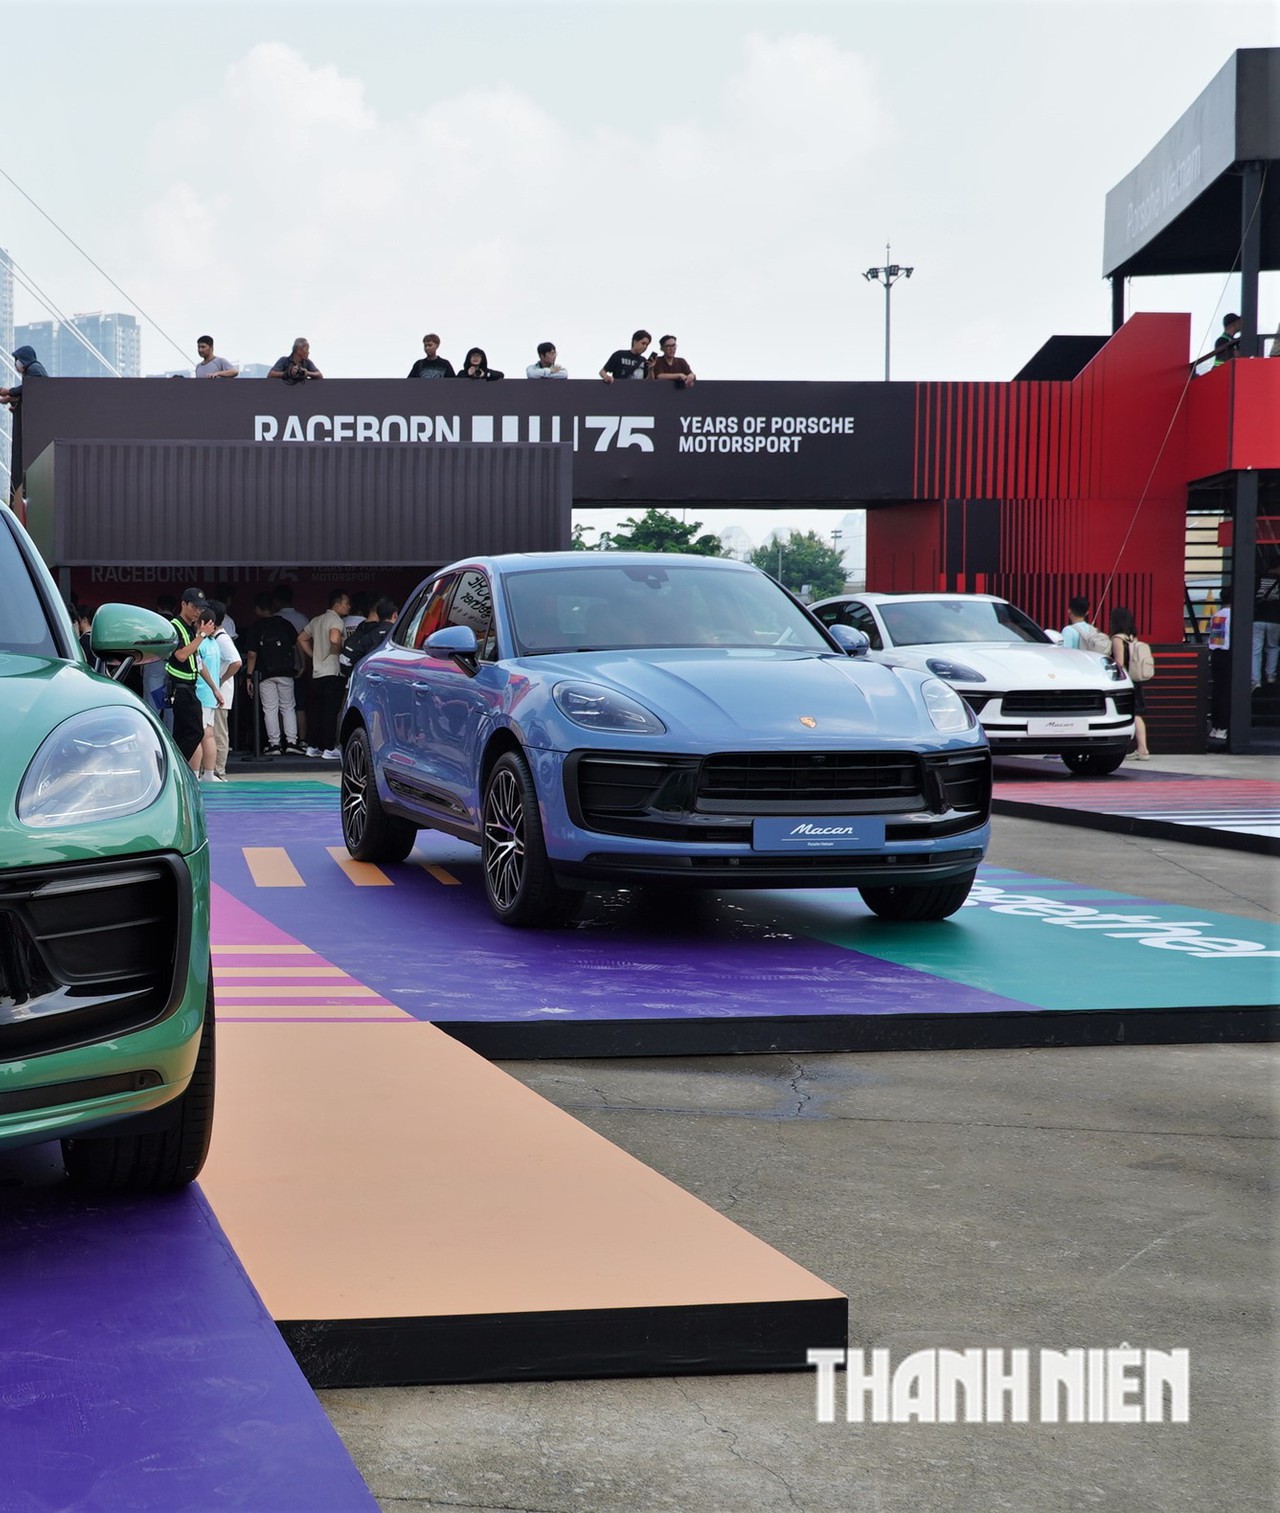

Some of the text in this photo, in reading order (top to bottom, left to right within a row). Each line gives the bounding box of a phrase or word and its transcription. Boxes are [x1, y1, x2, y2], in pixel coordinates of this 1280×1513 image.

[254, 415, 855, 452] RACEBORN 75 YEARS OF PORSCHE
[678, 436, 802, 453] MOTORSPORT
[91, 566, 198, 582] RACEBORN
[790, 823, 854, 835] Macan
